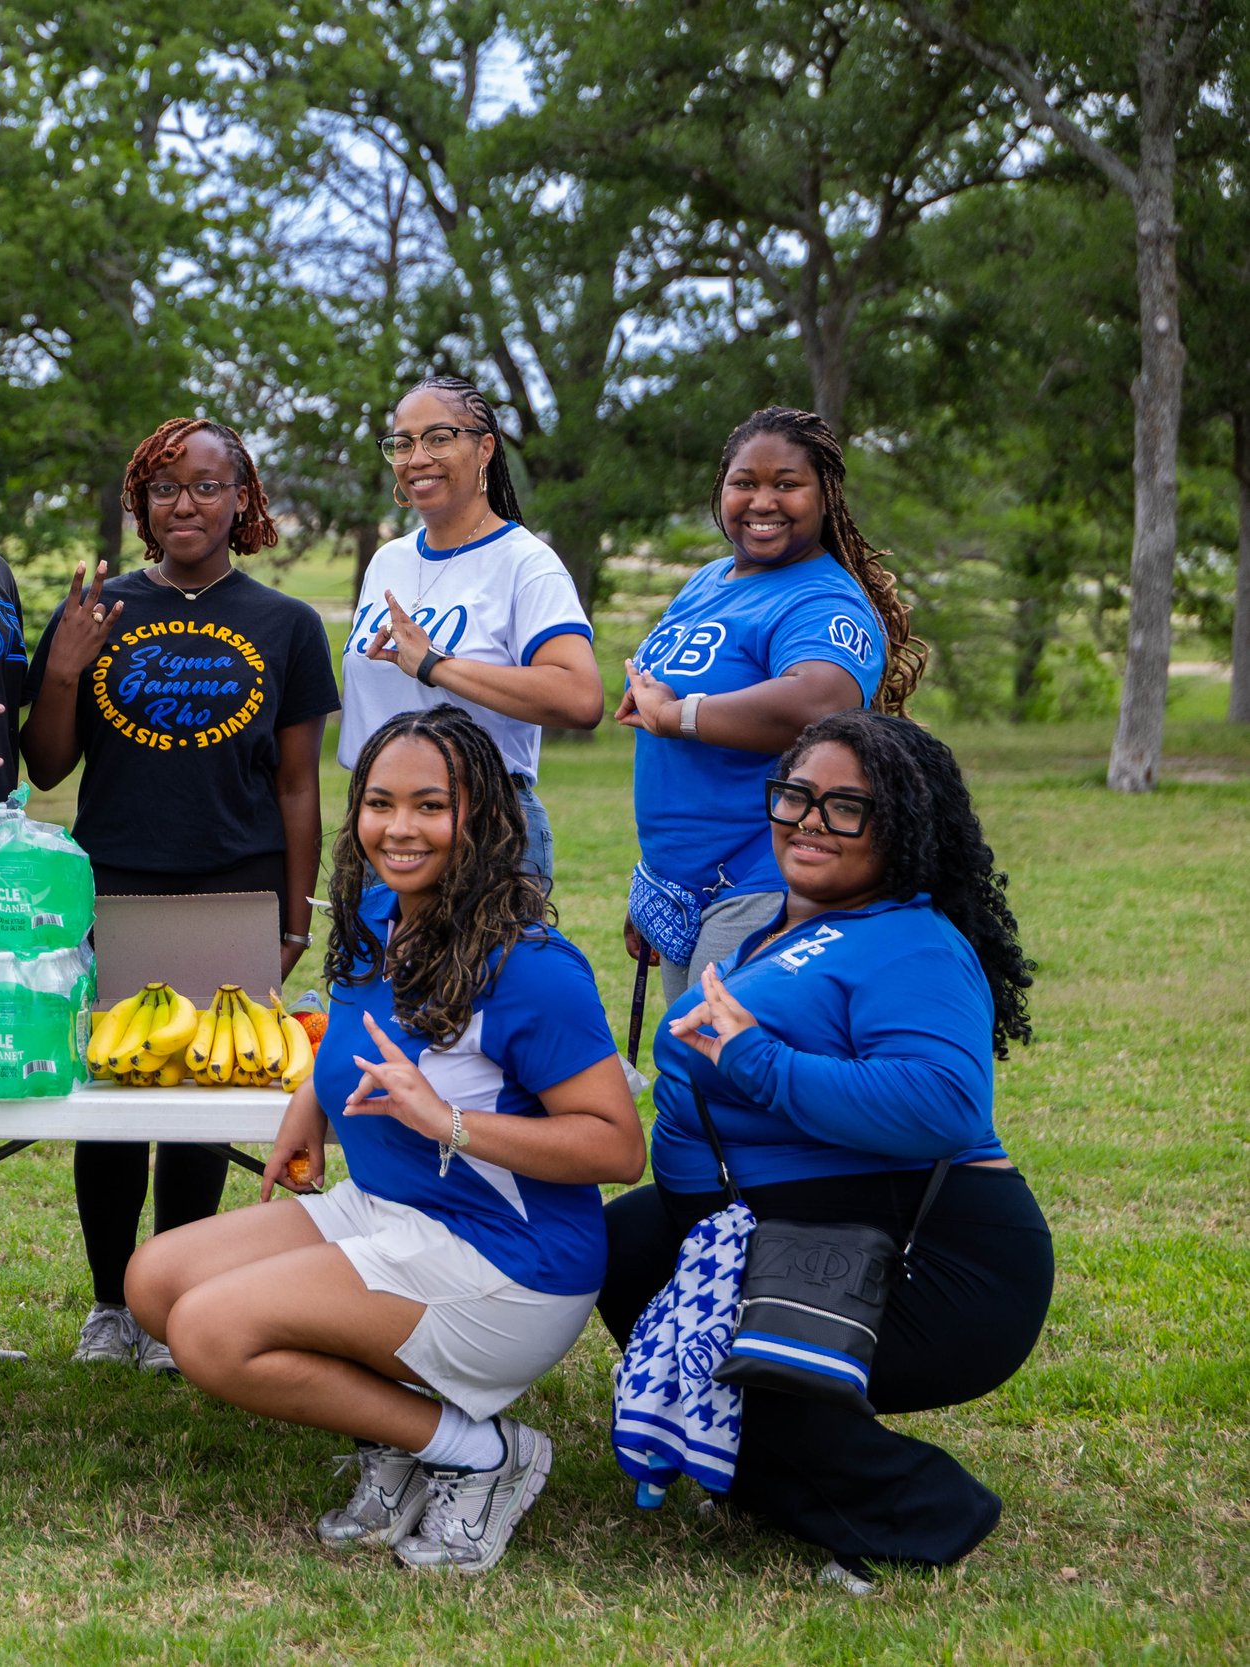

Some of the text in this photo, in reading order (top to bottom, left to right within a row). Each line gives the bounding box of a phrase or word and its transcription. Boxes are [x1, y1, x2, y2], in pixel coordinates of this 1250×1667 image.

[121, 621, 265, 673] SCHOLARSHIP
[128, 645, 236, 677] Sigma
[92, 655, 174, 751] SISTERHOOD
[118, 669, 242, 705] Gamma
[143, 697, 212, 730] Rho
[194, 688, 264, 748] SERVICE
